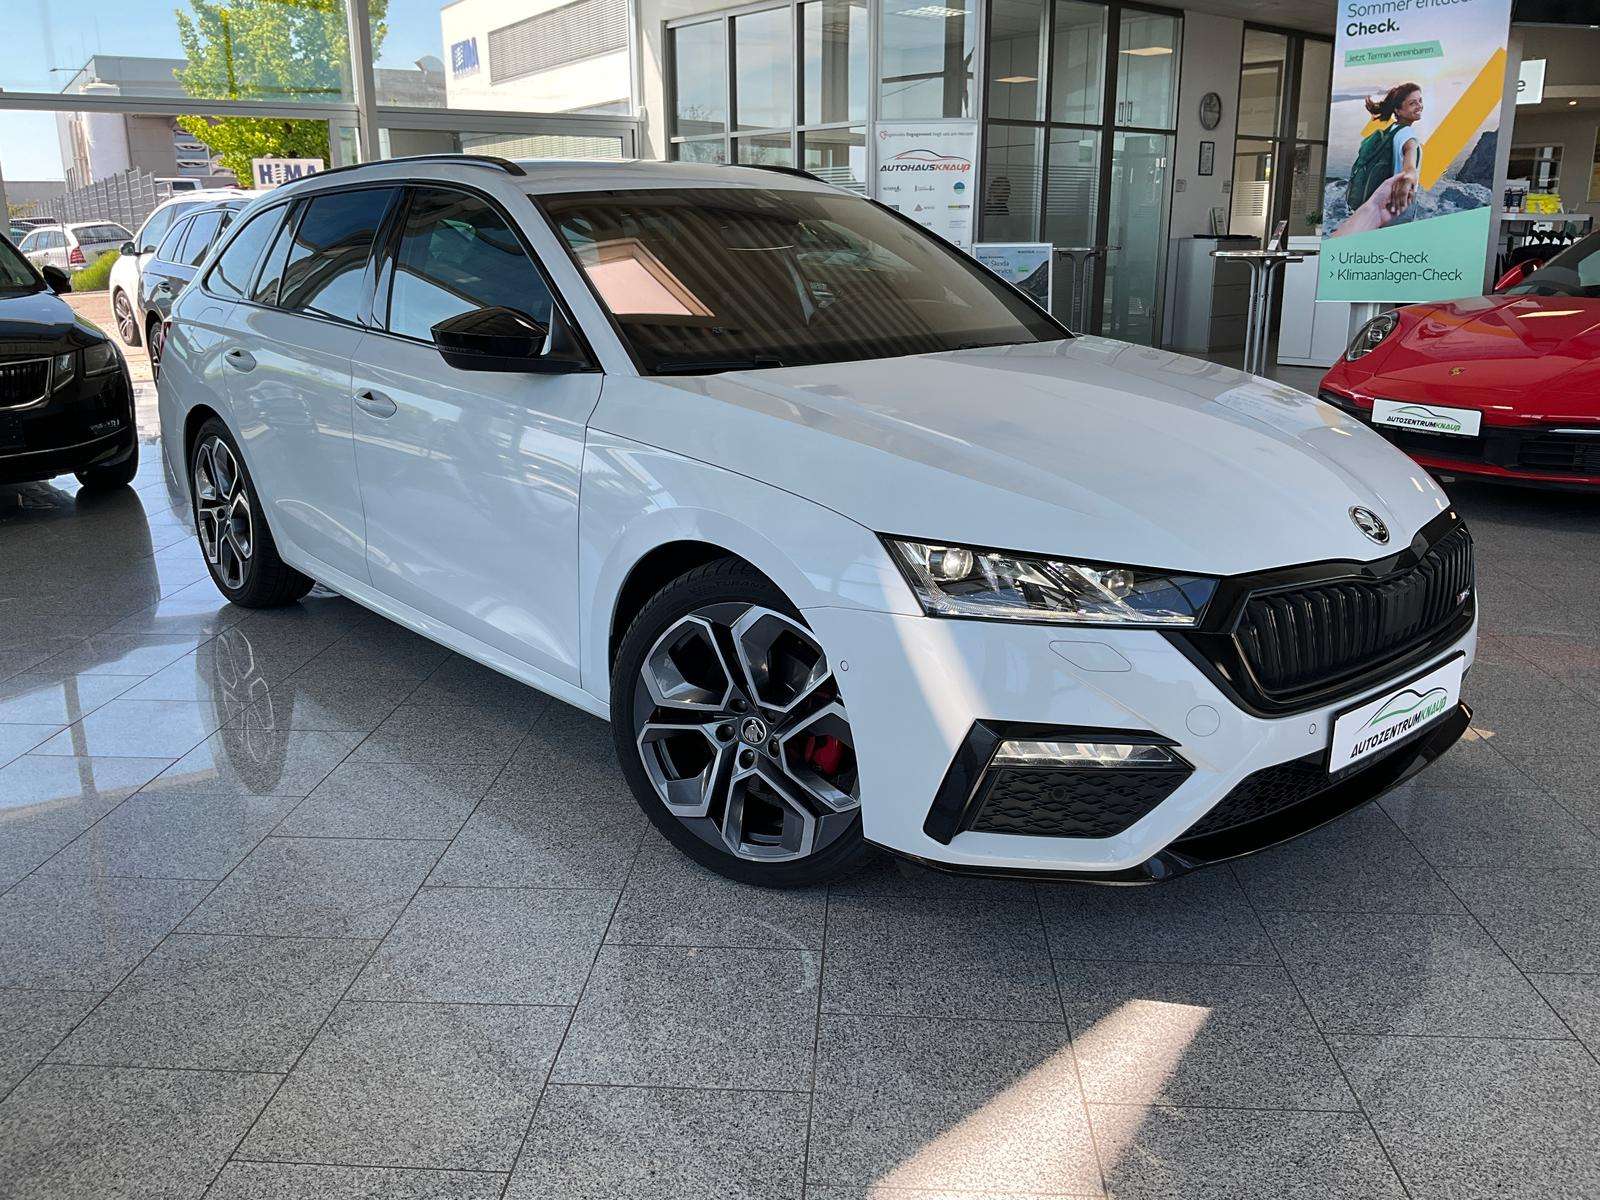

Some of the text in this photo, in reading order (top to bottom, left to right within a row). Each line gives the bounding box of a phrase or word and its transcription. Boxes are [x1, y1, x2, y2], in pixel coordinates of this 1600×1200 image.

[1348, 0, 1412, 17] Sommer
[1346, 18, 1400, 36] Check.
[1346, 47, 1434, 63] Jetzt Termin vereinbaren
[1338, 251, 1429, 264] Urlaubs-Check
[1337, 268, 1463, 283] Klimaanlagen-Check
